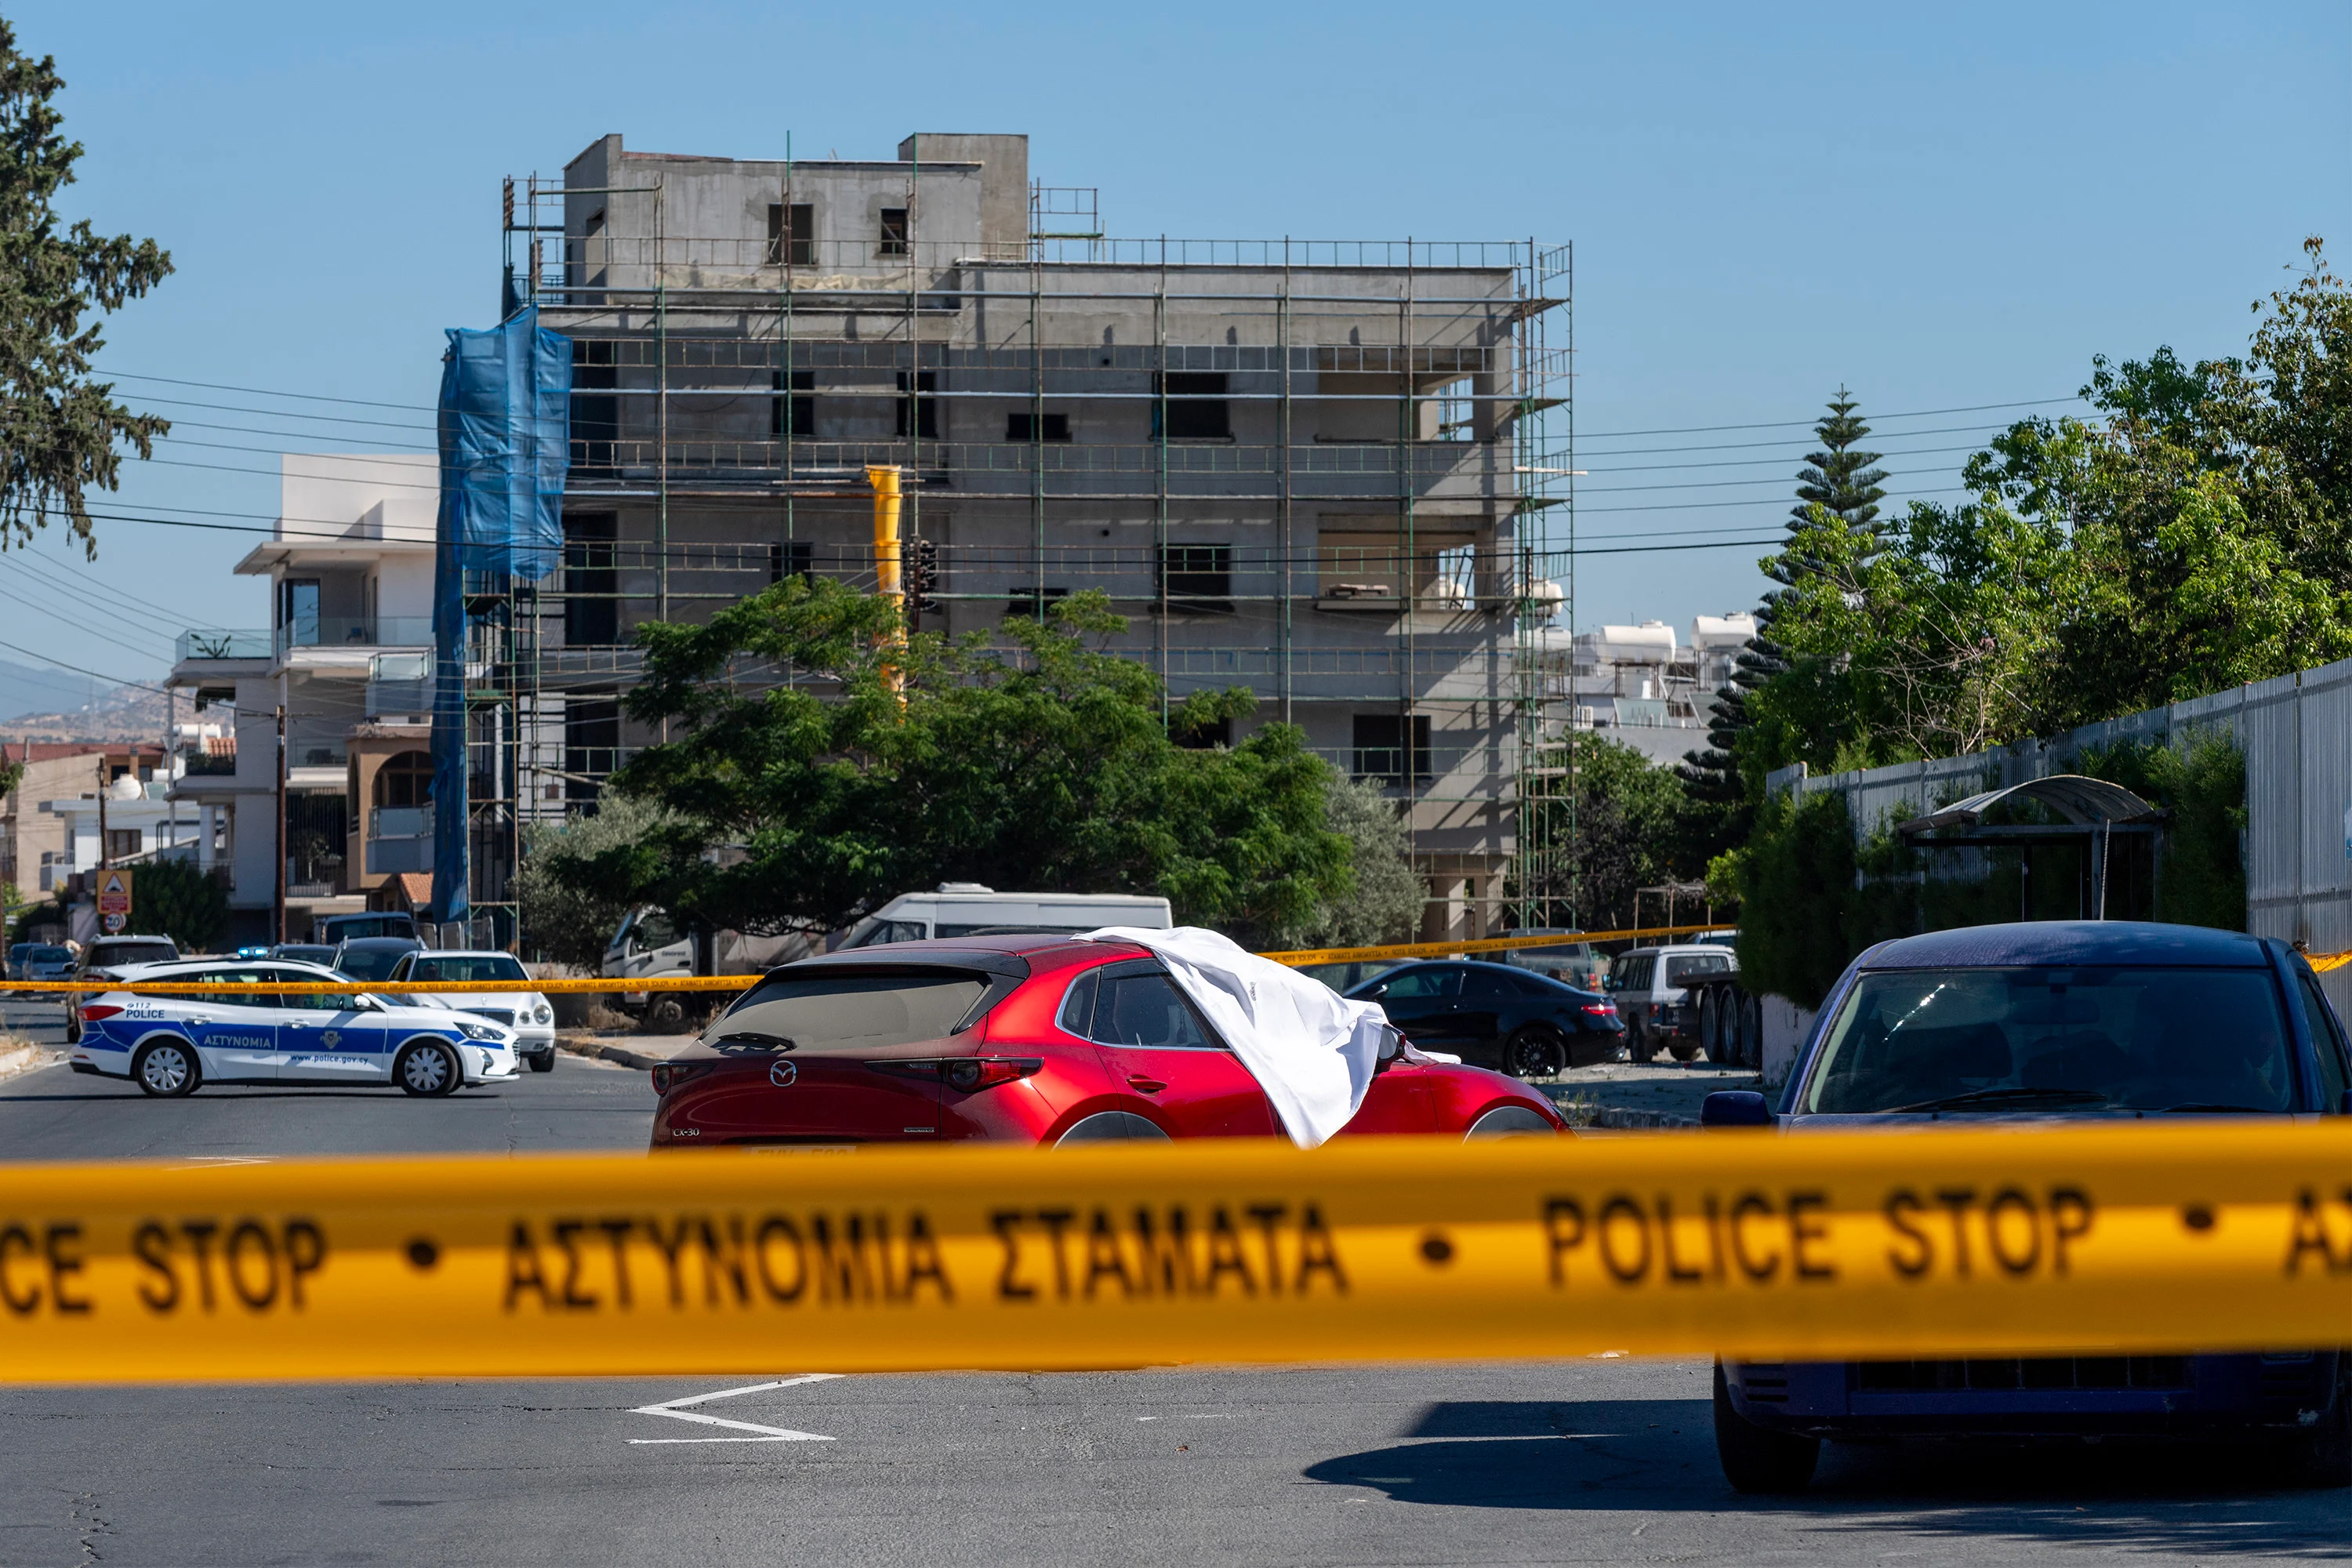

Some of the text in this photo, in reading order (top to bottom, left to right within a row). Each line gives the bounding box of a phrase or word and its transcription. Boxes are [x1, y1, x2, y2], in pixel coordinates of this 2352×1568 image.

[126, 1010, 165, 1018] POLICE
[204, 1035, 271, 1048] ΑΣΤΥΝΟΜΙΑ
[291, 1054, 368, 1065] www.police.gov.cy
[131, 1214, 329, 1317] STOP
[502, 1208, 956, 1315] ΑΣΤΥΝΟΜΙΑ
[989, 1198, 1350, 1302] ΣΤΑΜΑΤΑ
[1540, 1186, 1840, 1288] POLICE
[1882, 1181, 2094, 1281] STOP
